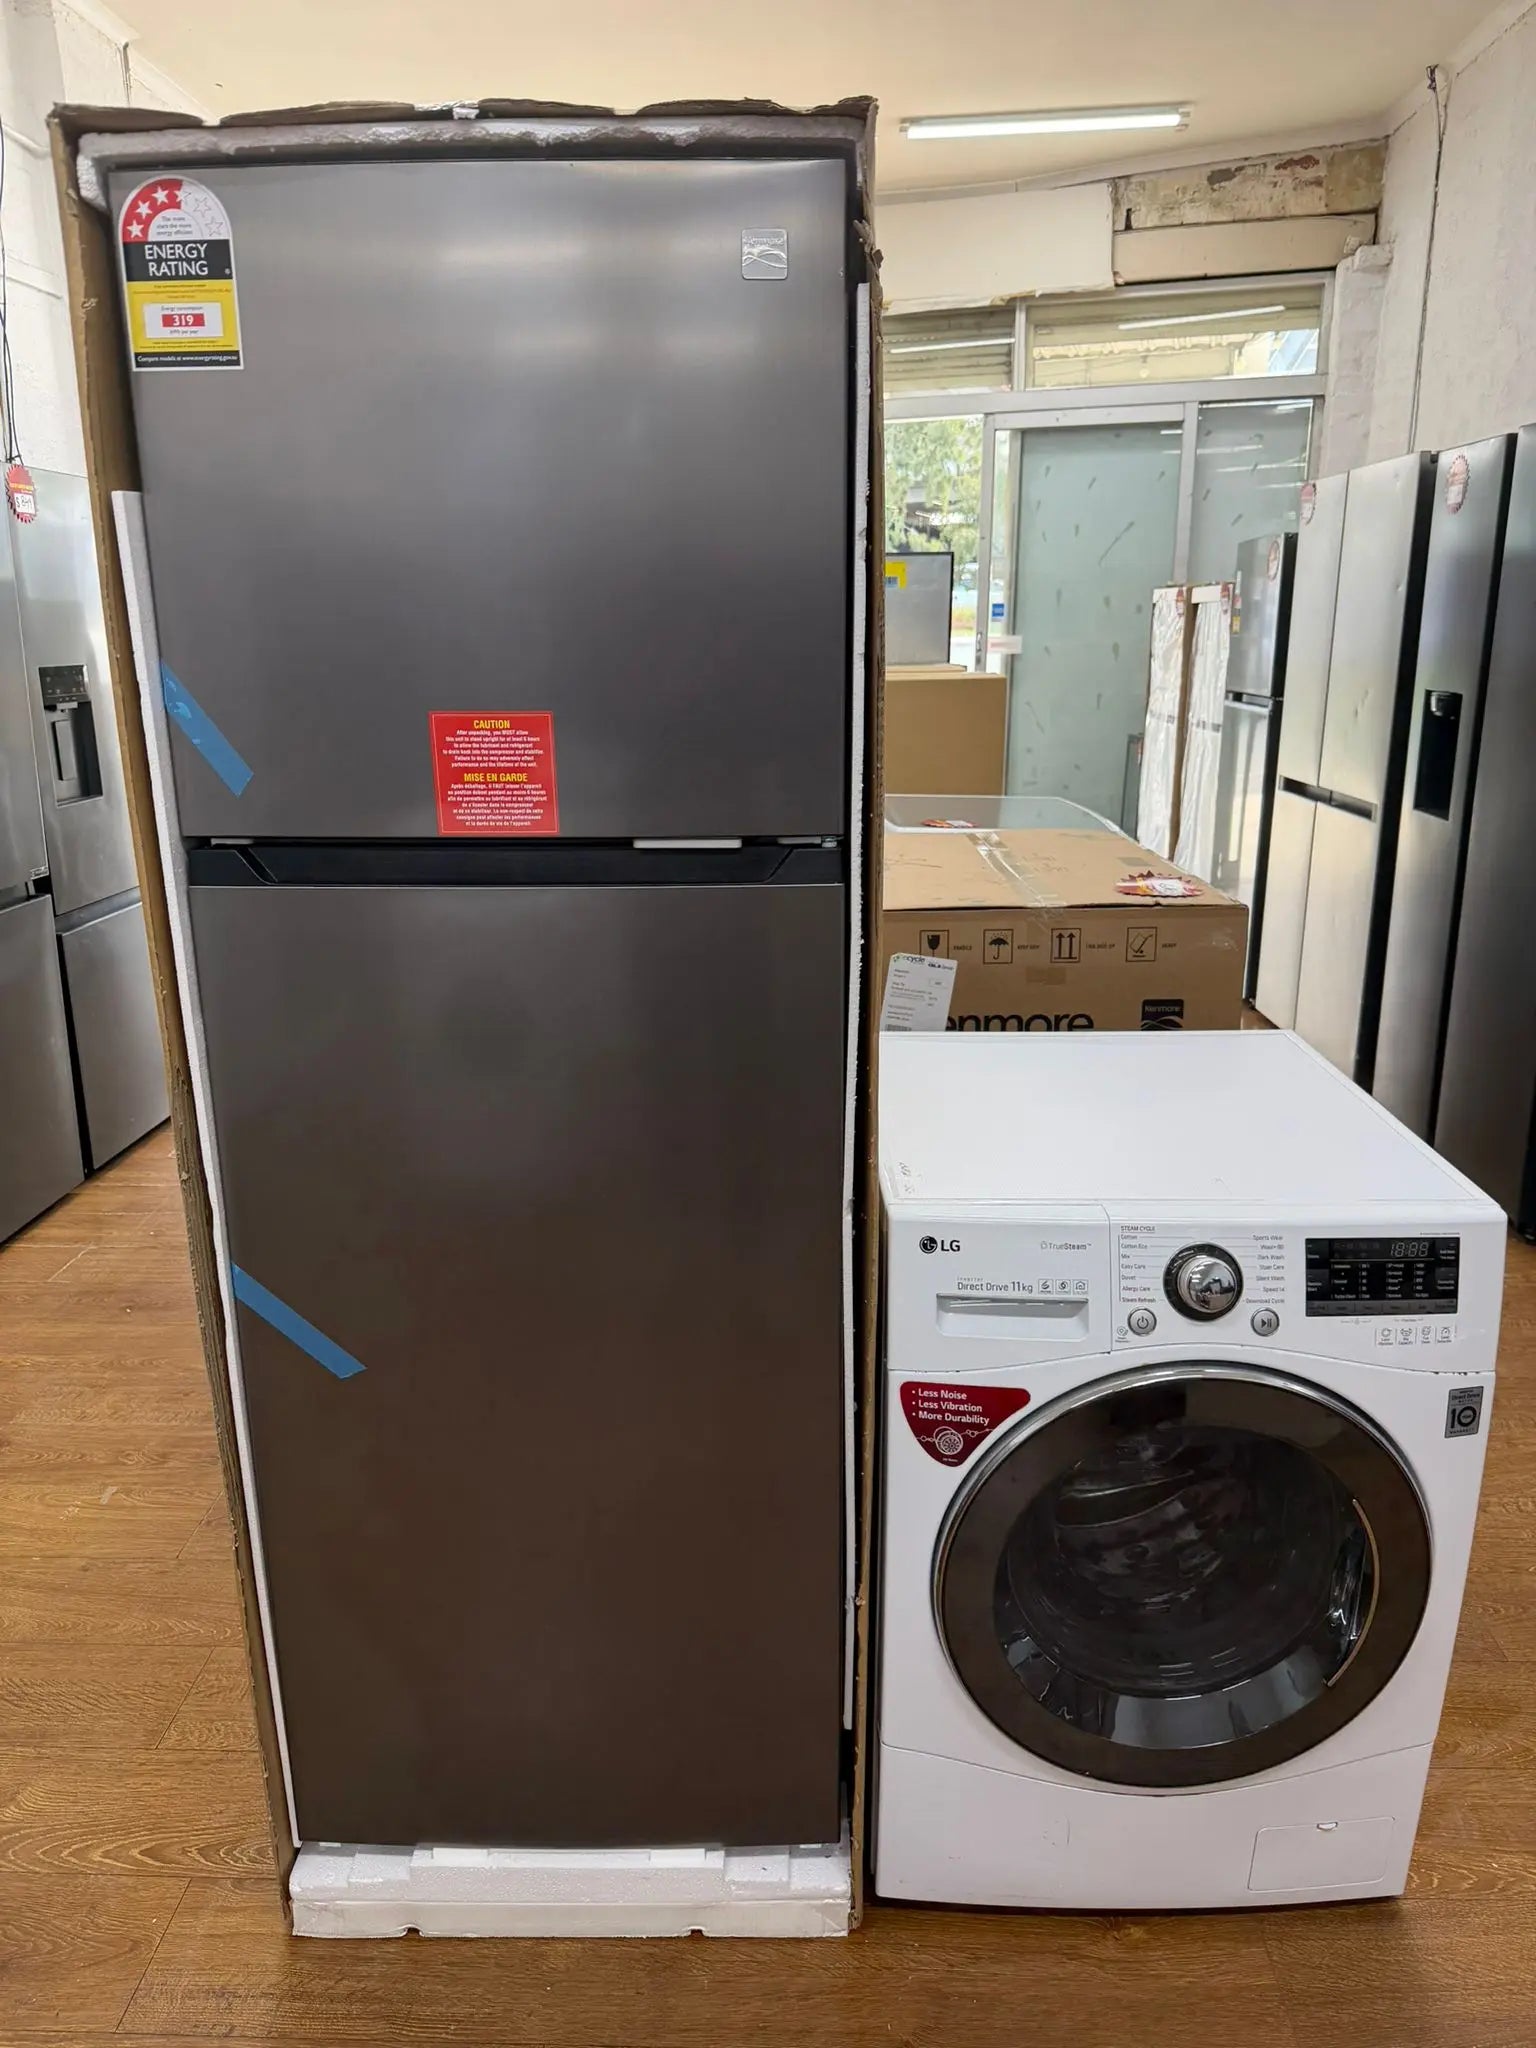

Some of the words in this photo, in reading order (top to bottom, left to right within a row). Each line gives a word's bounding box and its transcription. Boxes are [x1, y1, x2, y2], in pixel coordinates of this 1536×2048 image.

[145, 243, 208, 260] ENERGY
[149, 261, 208, 276] RATING
[173, 315, 194, 326] 319
[473, 720, 510, 729] CAUTION
[464, 773, 485, 782] MISE
[487, 773, 498, 782] EN
[500, 773, 528, 782] GARDE
[940, 1239, 961, 1252] LG
[957, 1282, 984, 1291] Direct
[986, 1283, 1009, 1291] Drive
[1011, 1282, 1033, 1294] 11kg
[919, 1388, 939, 1398] Less
[940, 1390, 967, 1400] Noise
[919, 1400, 939, 1409] Less
[940, 1401, 983, 1412] Vibration
[919, 1411, 943, 1420] More
[944, 1413, 990, 1426] Durability
